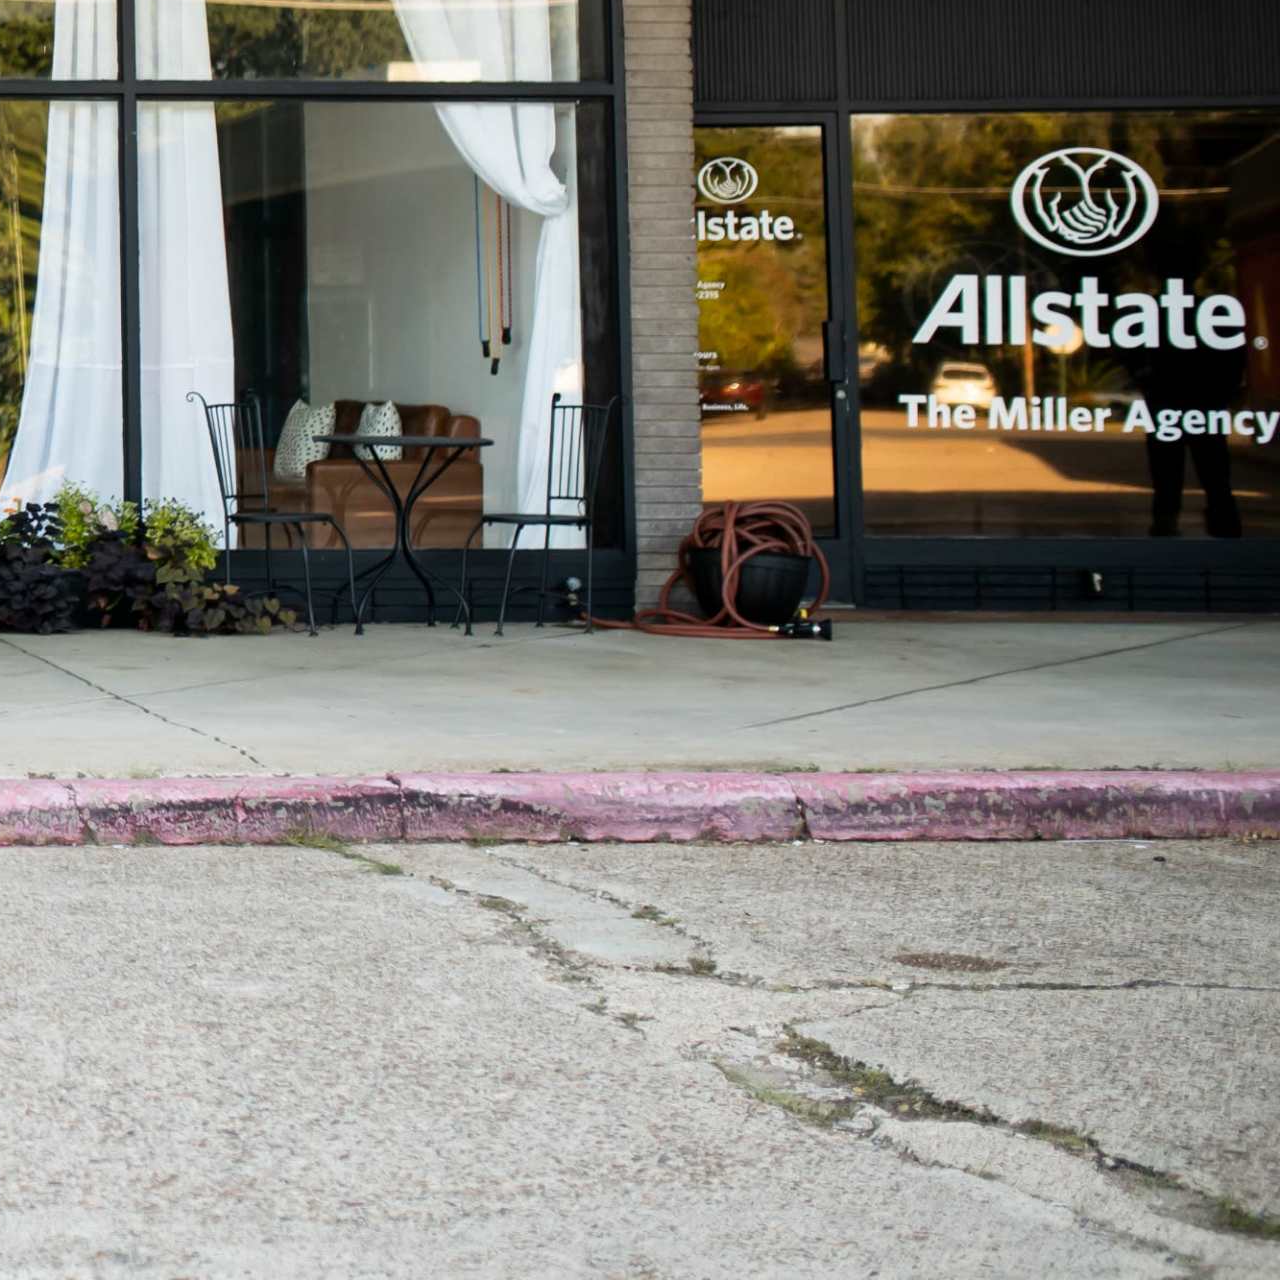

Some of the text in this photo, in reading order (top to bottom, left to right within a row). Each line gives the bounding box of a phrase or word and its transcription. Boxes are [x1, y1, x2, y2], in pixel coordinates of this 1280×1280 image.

[912, 274, 1247, 350] Allstate
[898, 394, 1280, 444] The Miller Agency
